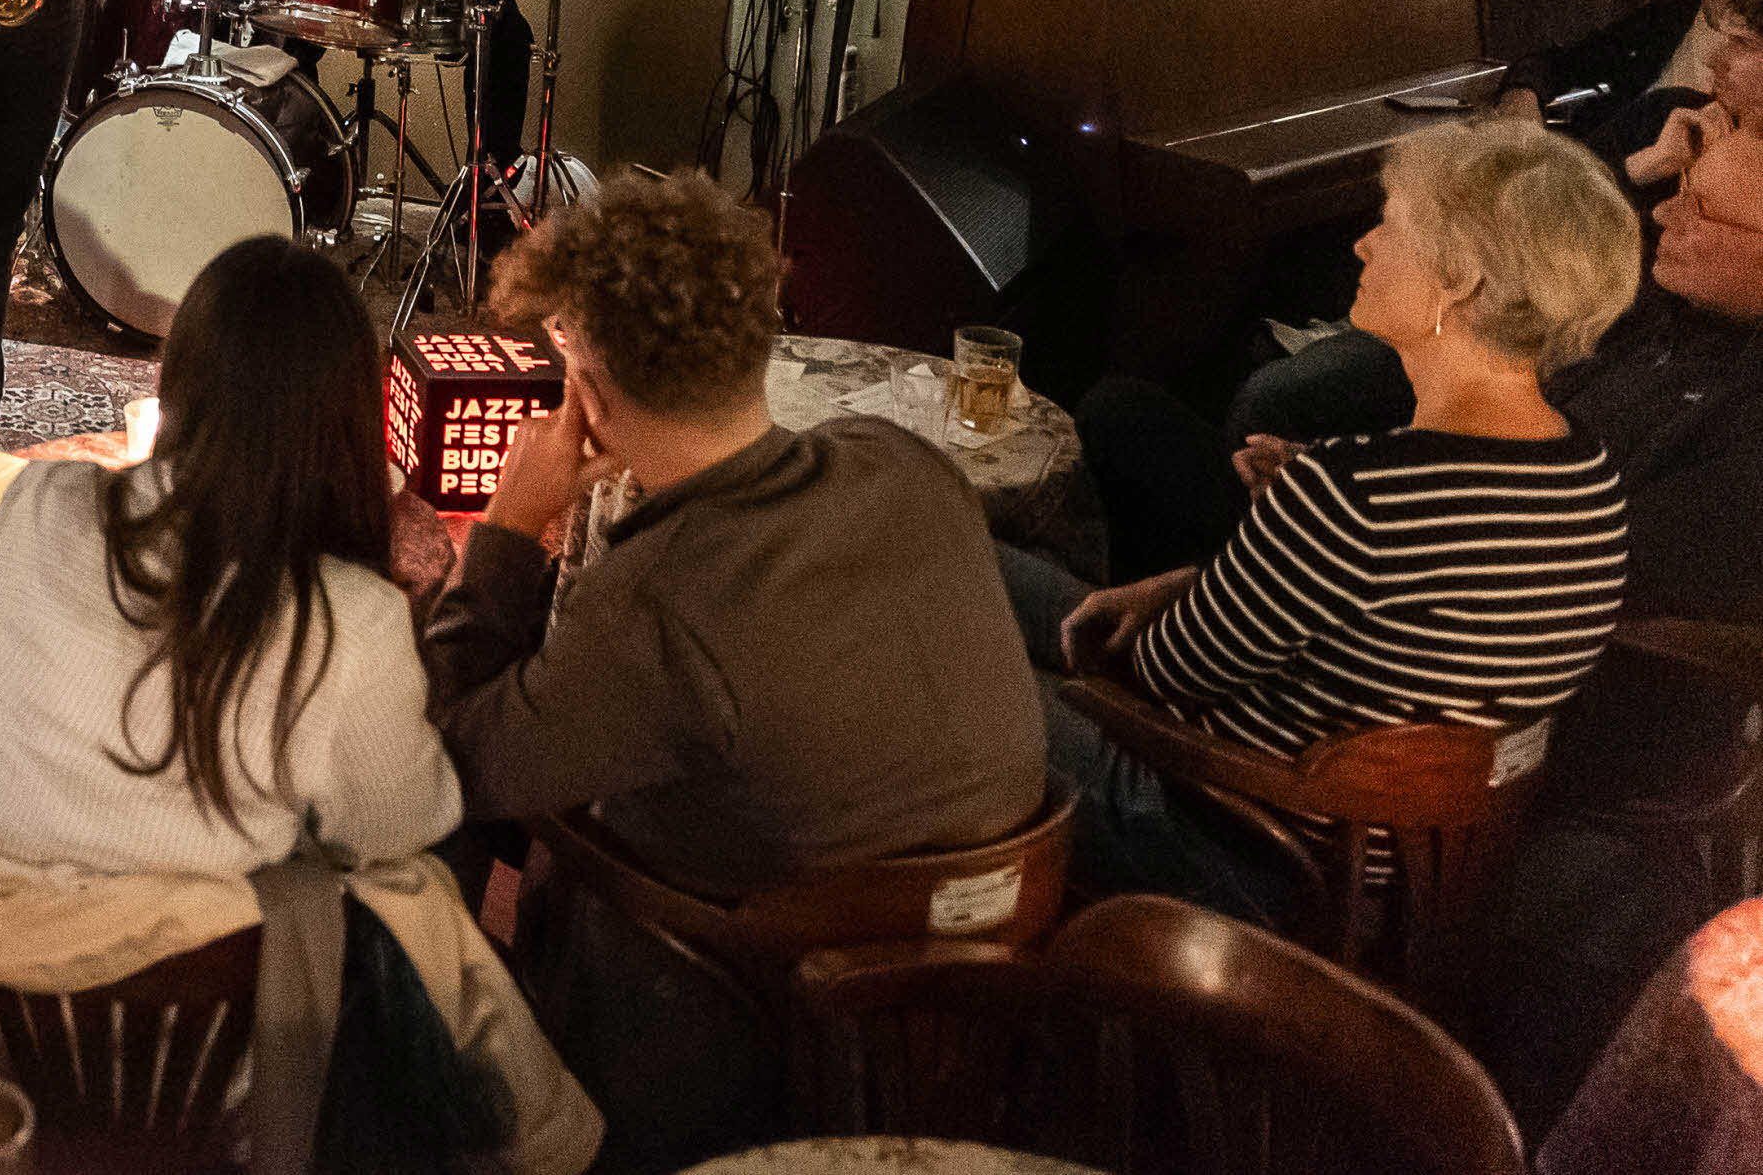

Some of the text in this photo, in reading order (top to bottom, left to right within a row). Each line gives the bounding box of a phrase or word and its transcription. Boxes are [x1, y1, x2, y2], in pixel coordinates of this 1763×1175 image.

[413, 335, 489, 344] JAZZ
[423, 353, 504, 363] BUDA
[430, 362, 506, 372] PEST
[445, 399, 524, 421] JAZZ
[440, 473, 503, 494] PES
